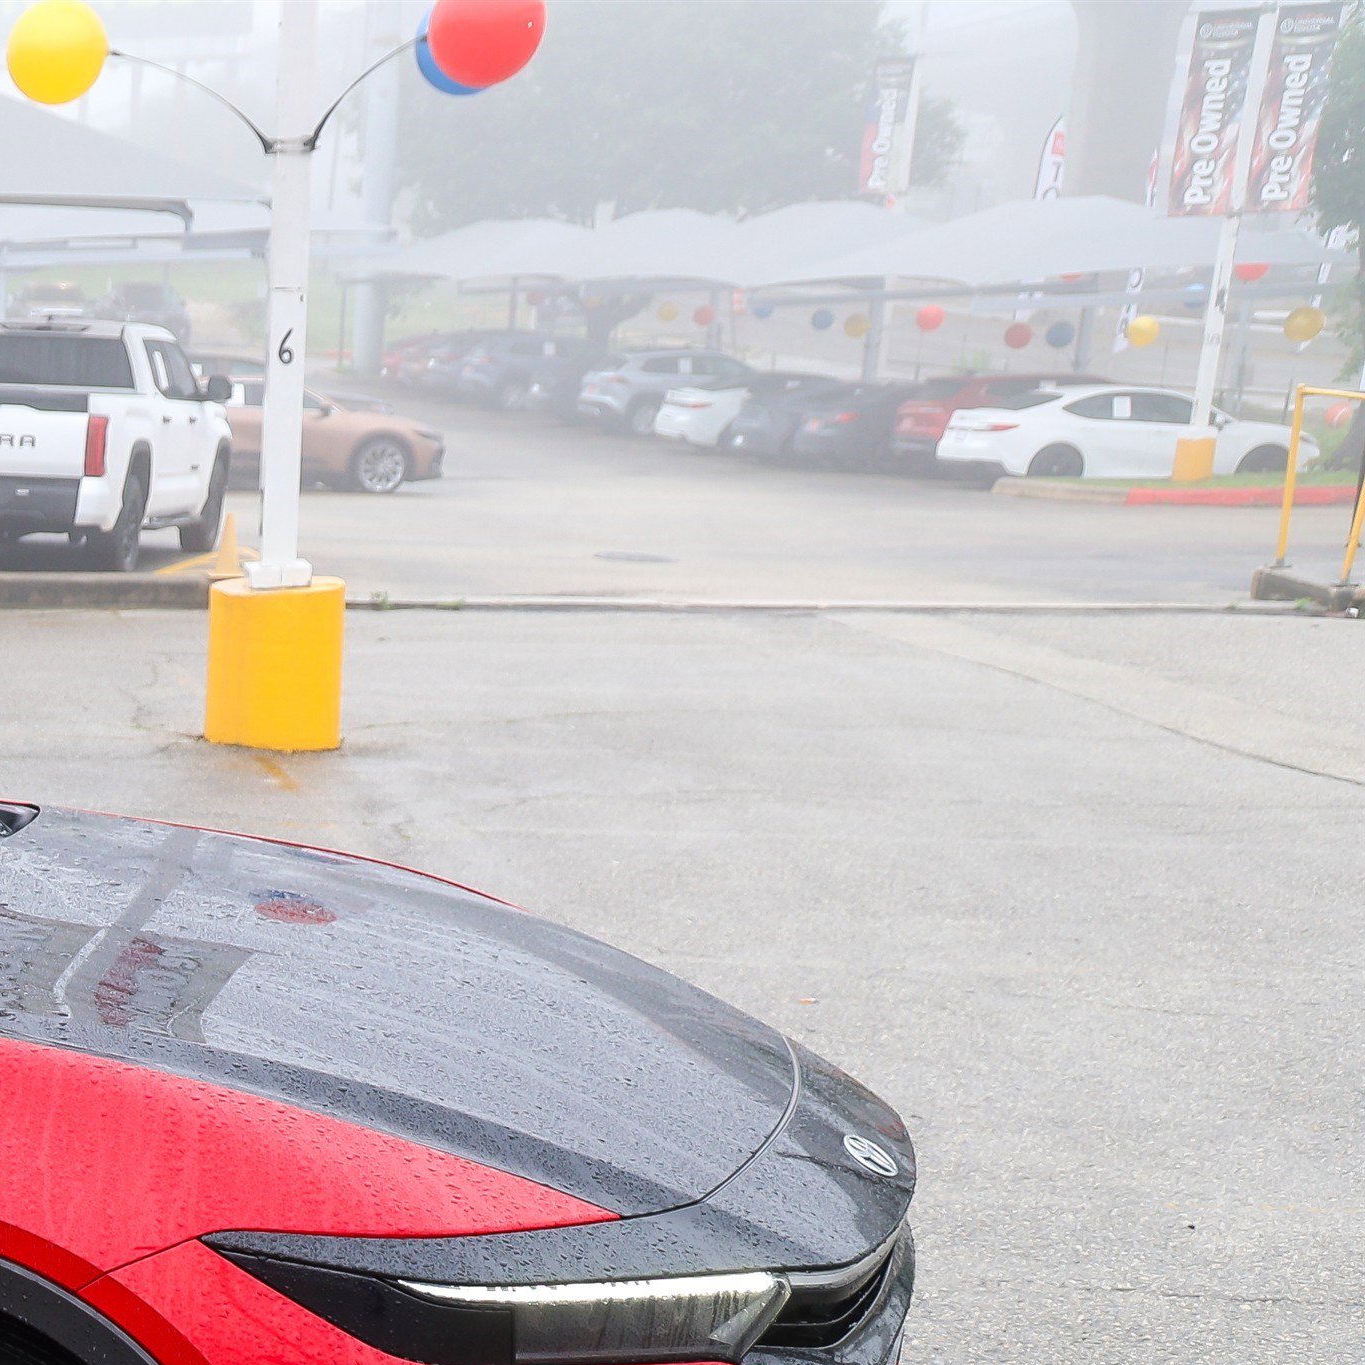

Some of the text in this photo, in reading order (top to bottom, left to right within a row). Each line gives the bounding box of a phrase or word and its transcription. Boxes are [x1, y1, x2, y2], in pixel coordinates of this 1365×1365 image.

[1184, 58, 1231, 204] Pre Owned
[1261, 53, 1313, 201] Pre Owned
[279, 326, 294, 364] 6
